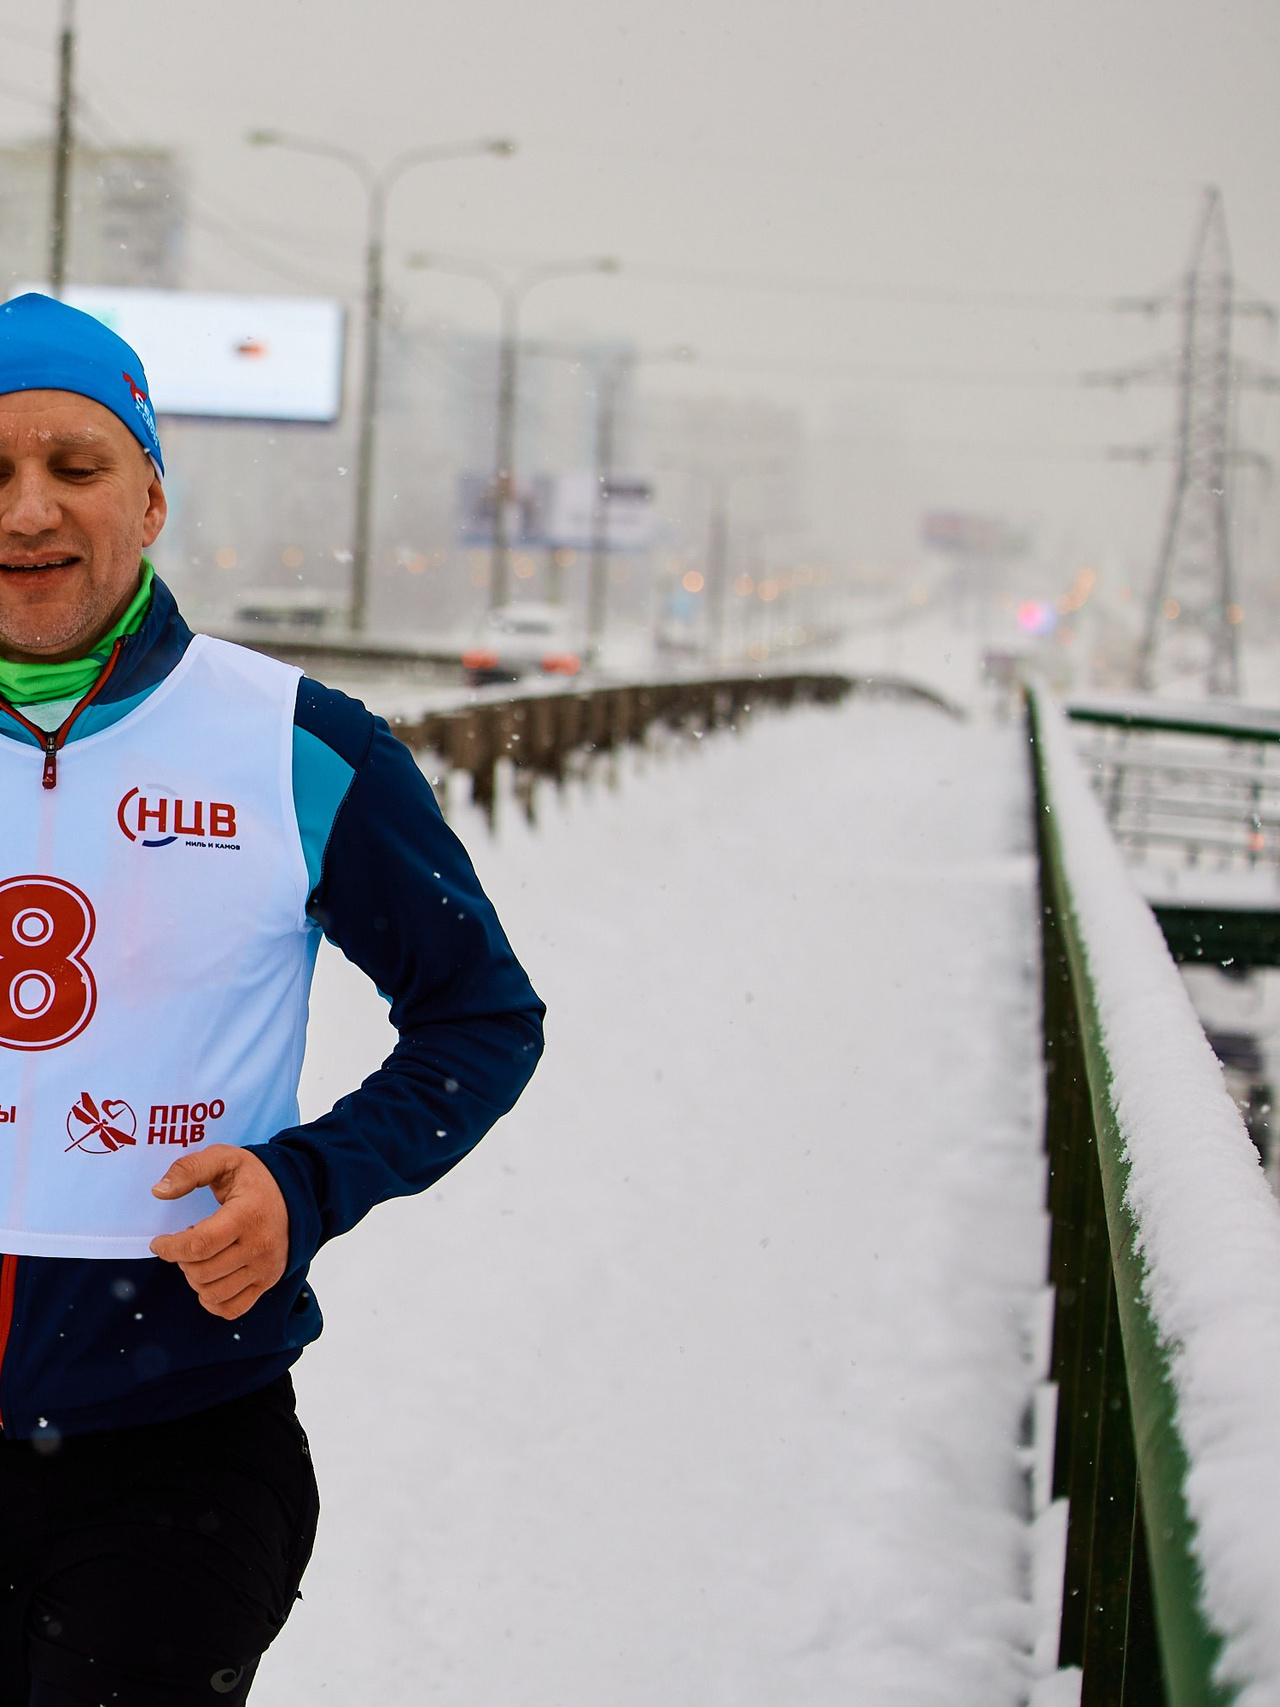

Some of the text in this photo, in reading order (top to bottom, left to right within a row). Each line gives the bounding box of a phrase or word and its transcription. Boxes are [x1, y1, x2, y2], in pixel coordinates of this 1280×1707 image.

[215, 843, 241, 851] КАМОВ
[149, 1099, 225, 1124] ППОО
[147, 1123, 205, 1148] НЦВ
